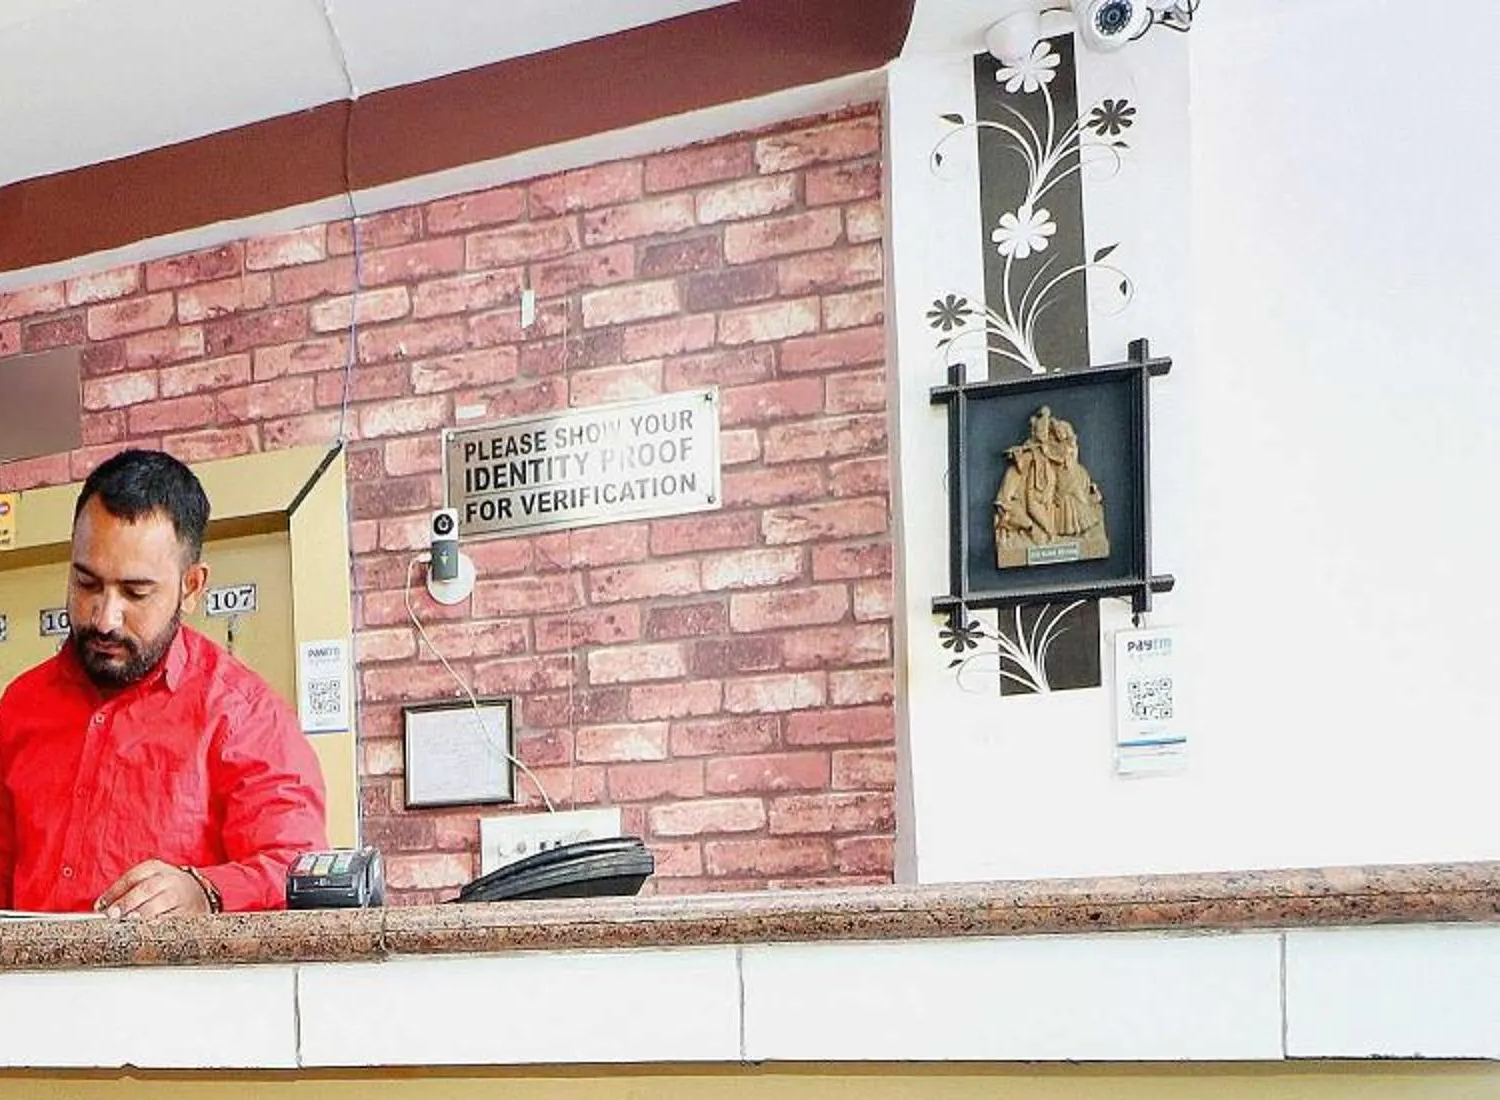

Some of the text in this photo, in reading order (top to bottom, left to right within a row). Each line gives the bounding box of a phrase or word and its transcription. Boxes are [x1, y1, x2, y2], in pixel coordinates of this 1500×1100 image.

[464, 409, 693, 463] PLEASE SHOW YOUR
[465, 437, 693, 493] IDENTITY PROOF
[466, 472, 698, 523] FOR VERIFICATION
[46, 612, 69, 631] 10
[211, 588, 252, 611] 107
